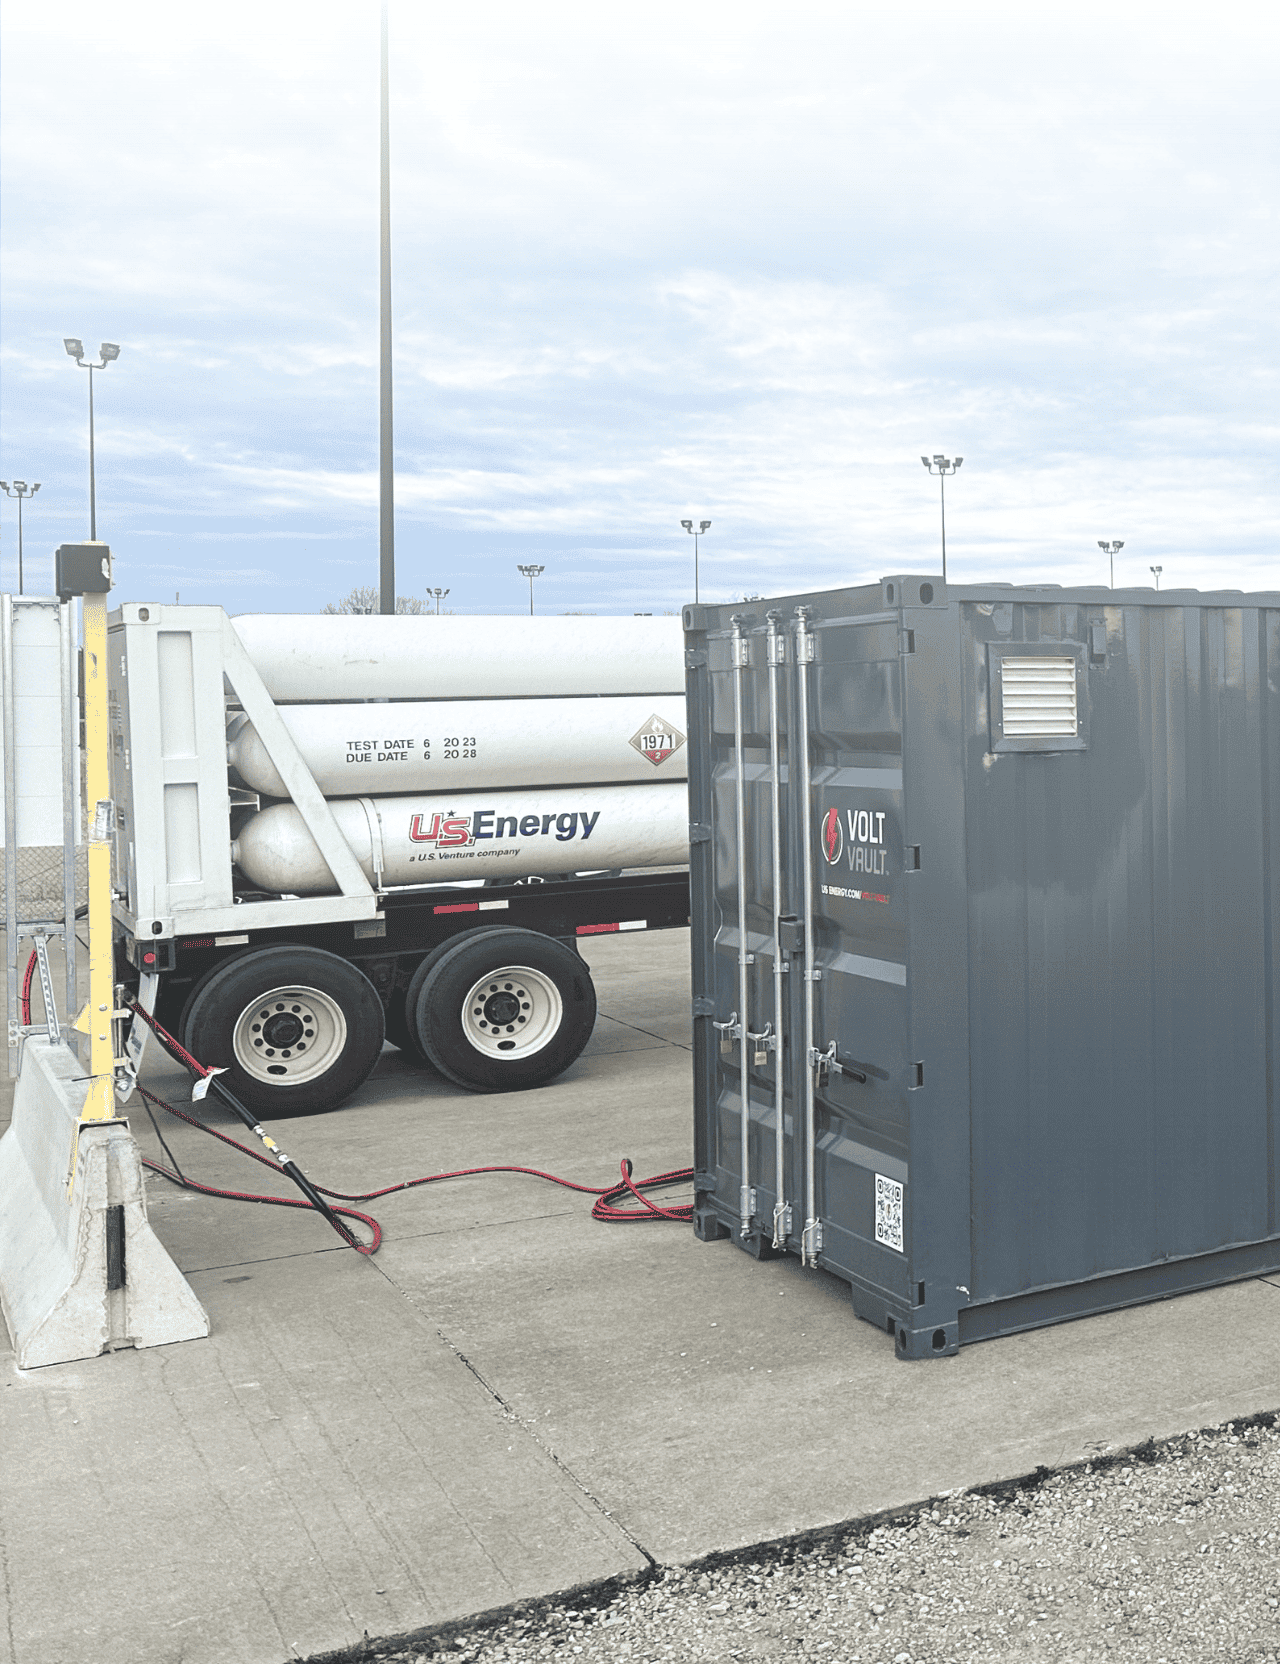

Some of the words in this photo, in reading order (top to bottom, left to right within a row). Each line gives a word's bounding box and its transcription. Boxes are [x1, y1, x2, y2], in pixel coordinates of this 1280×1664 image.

[346, 740, 379, 751] TEST
[383, 739, 415, 750] DATE
[423, 738, 431, 748] 6
[642, 734, 673, 750] 1971
[346, 753, 372, 763] DUE
[377, 751, 408, 762] DATE
[423, 750, 431, 760] 6
[655, 751, 661, 760] 2
[472, 810, 601, 842] Energy
[847, 809, 886, 845] VOLT
[418, 853, 436, 862] U.S.
[438, 851, 475, 860] Venture
[476, 848, 521, 858] company
[847, 845, 887, 876] VAULT
